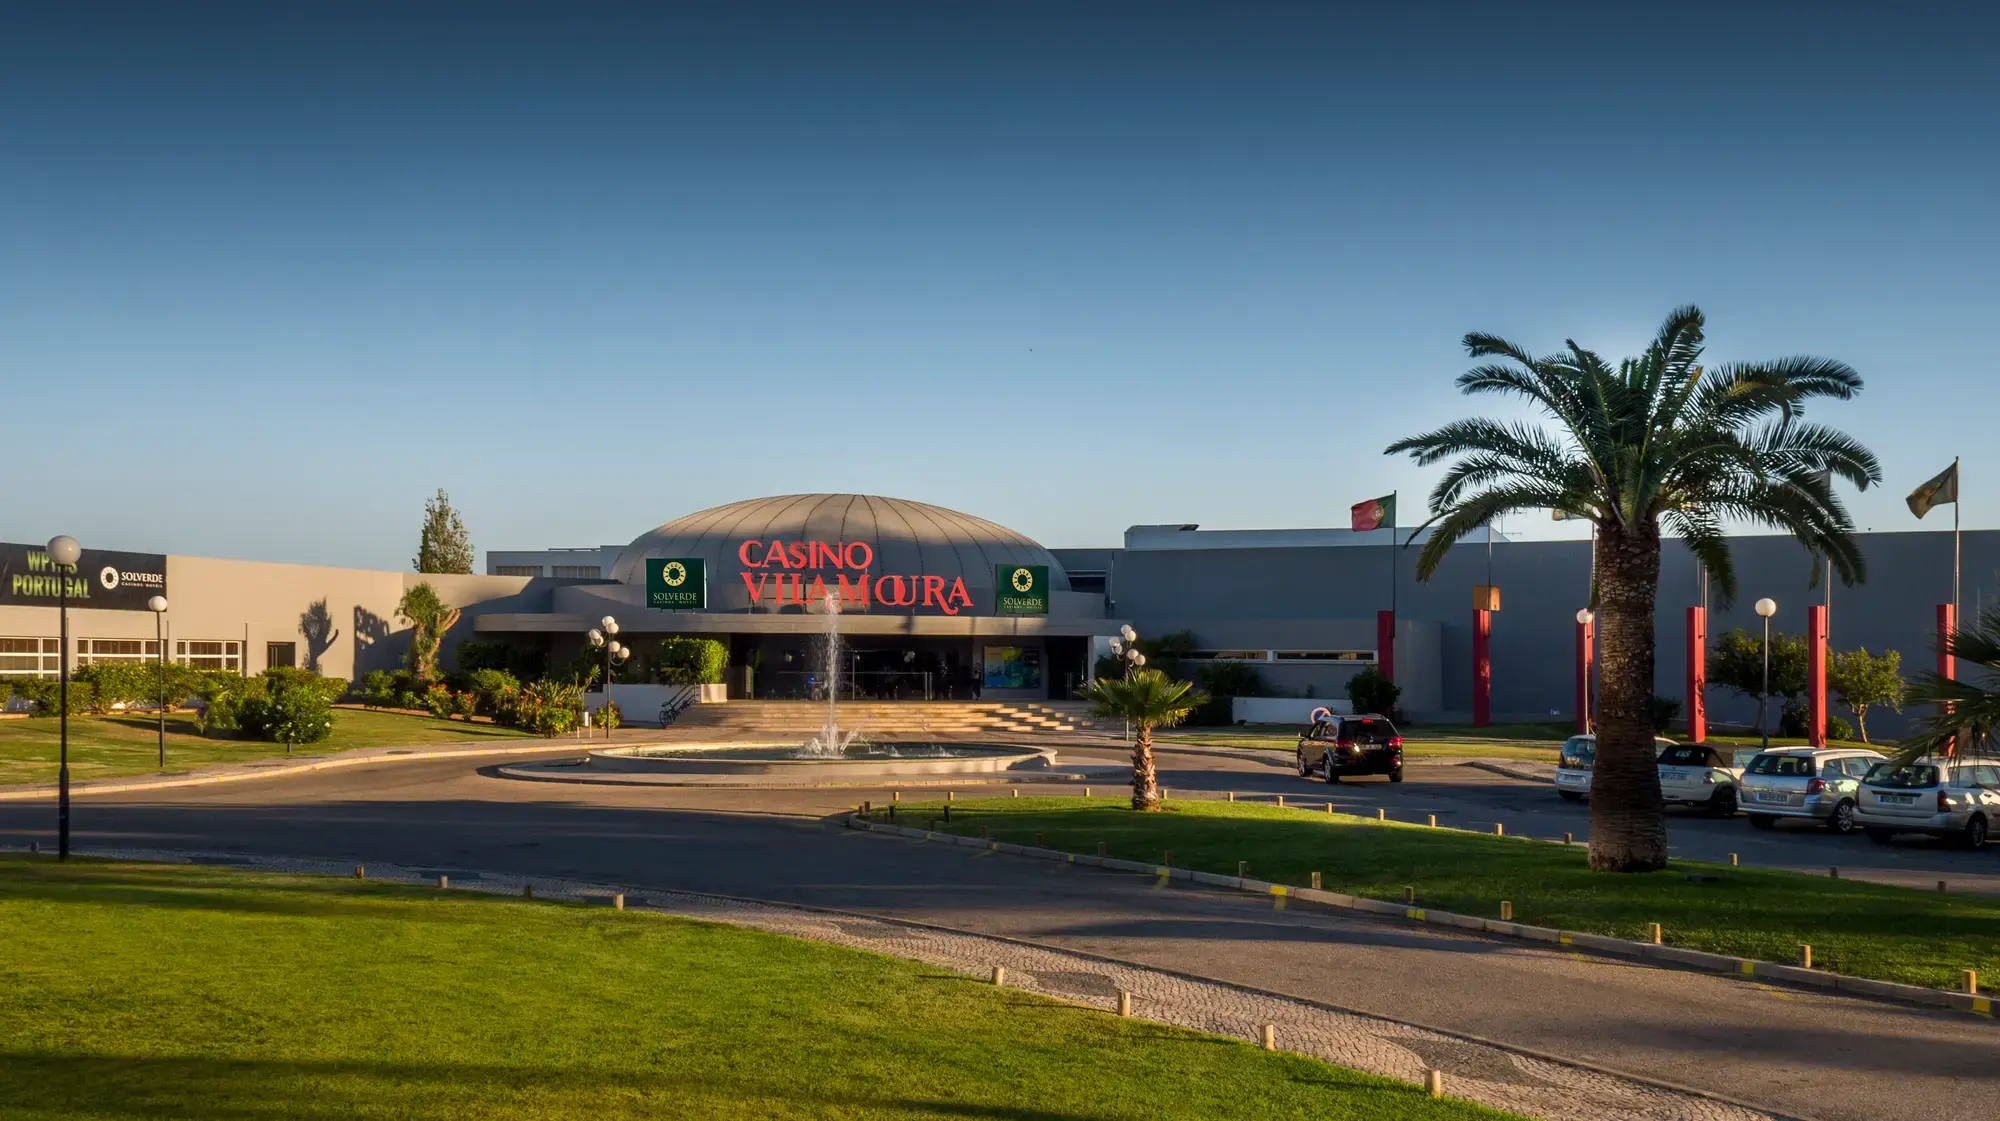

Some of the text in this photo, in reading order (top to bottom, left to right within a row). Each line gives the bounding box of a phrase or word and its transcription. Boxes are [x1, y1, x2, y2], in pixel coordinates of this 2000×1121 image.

[738, 539, 873, 570] CASINO
[121, 571, 163, 583] SOLVERDE
[12, 574, 91, 599] PORTUGAL
[740, 572, 974, 615] VILAMOURA
[653, 592, 697, 601] SOLVERDE
[1003, 597, 1042, 607] SOLVERDE
